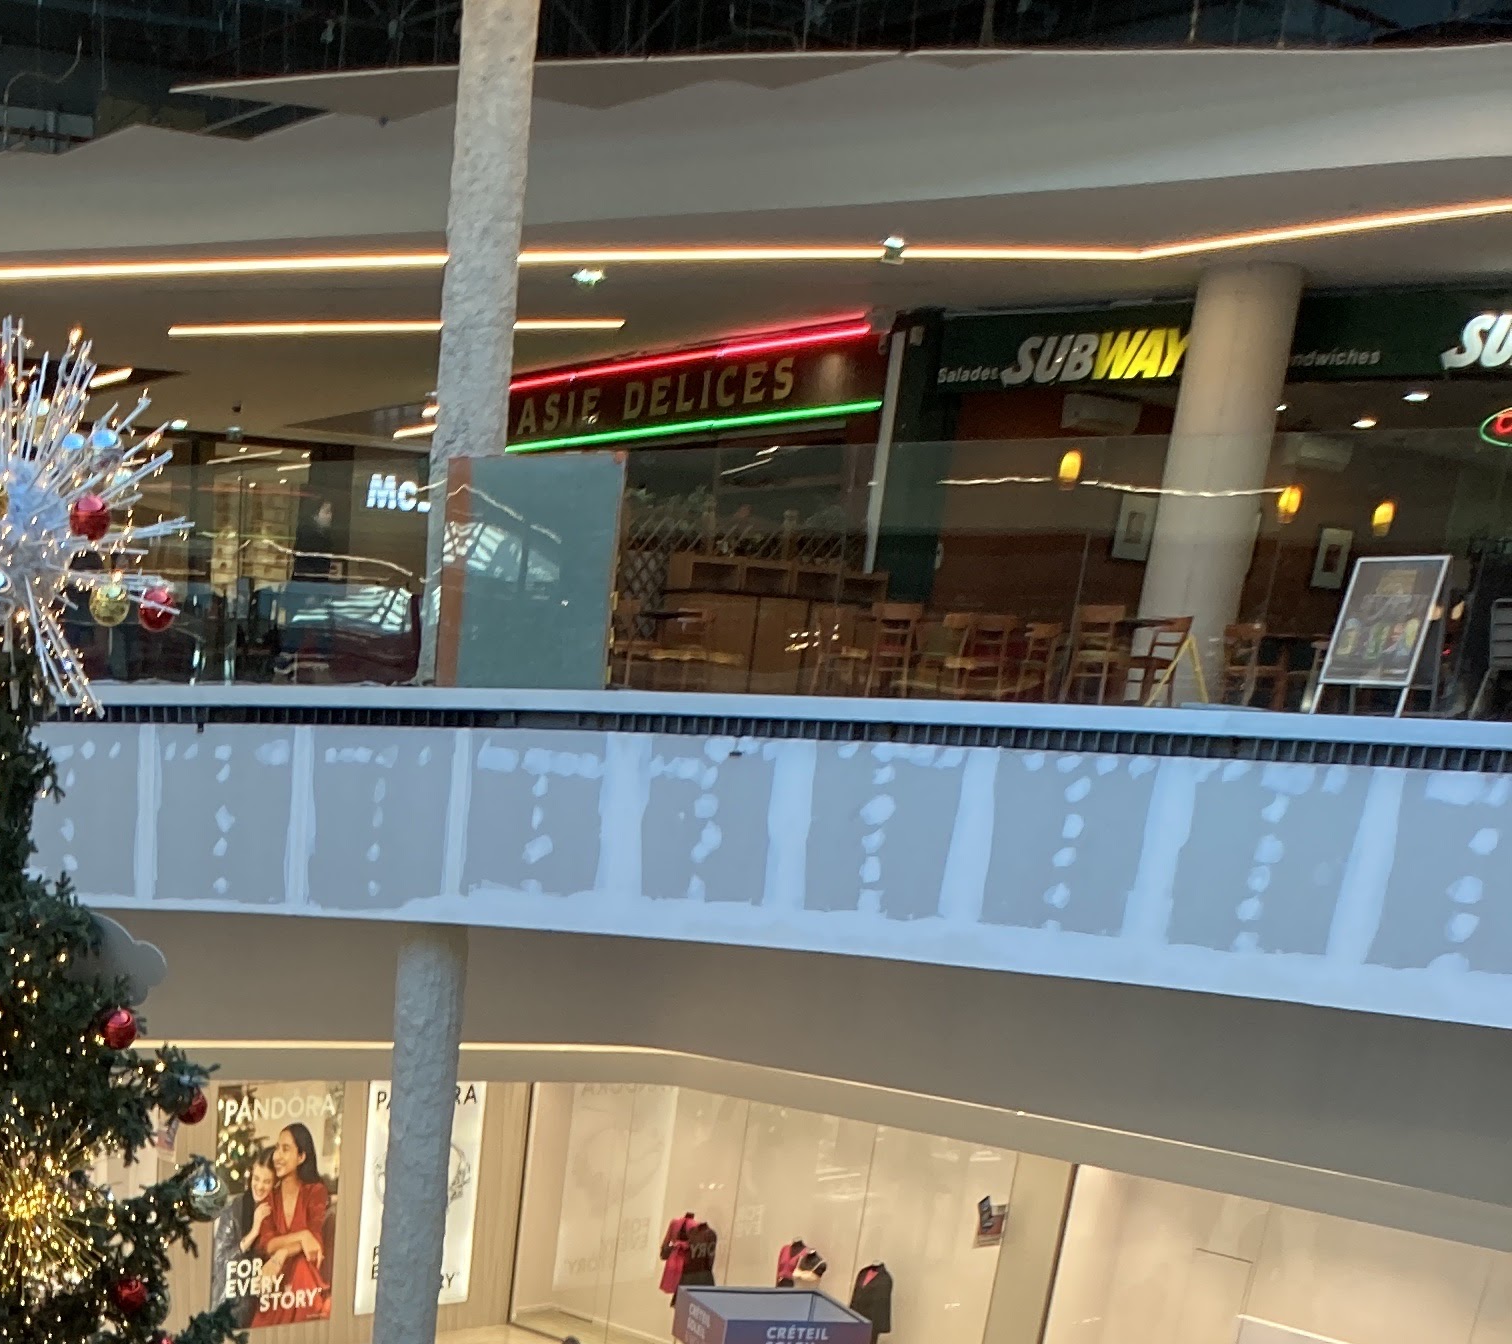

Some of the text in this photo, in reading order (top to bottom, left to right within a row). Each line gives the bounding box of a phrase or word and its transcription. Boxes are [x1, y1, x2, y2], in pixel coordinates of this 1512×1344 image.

[1441, 313, 1512, 370] SU
[1000, 327, 1190, 388] SUBWAY
[1292, 348, 1381, 368] ndwiches
[937, 366, 999, 384] Salades
[516, 356, 796, 436] ASIE DELICES
[222, 1092, 337, 1127] PANDORA
[226, 1257, 263, 1281] FOR
[225, 1273, 284, 1298] EVERY
[259, 1288, 319, 1313] STORY
[766, 1324, 829, 1341] CRÉTEIL
